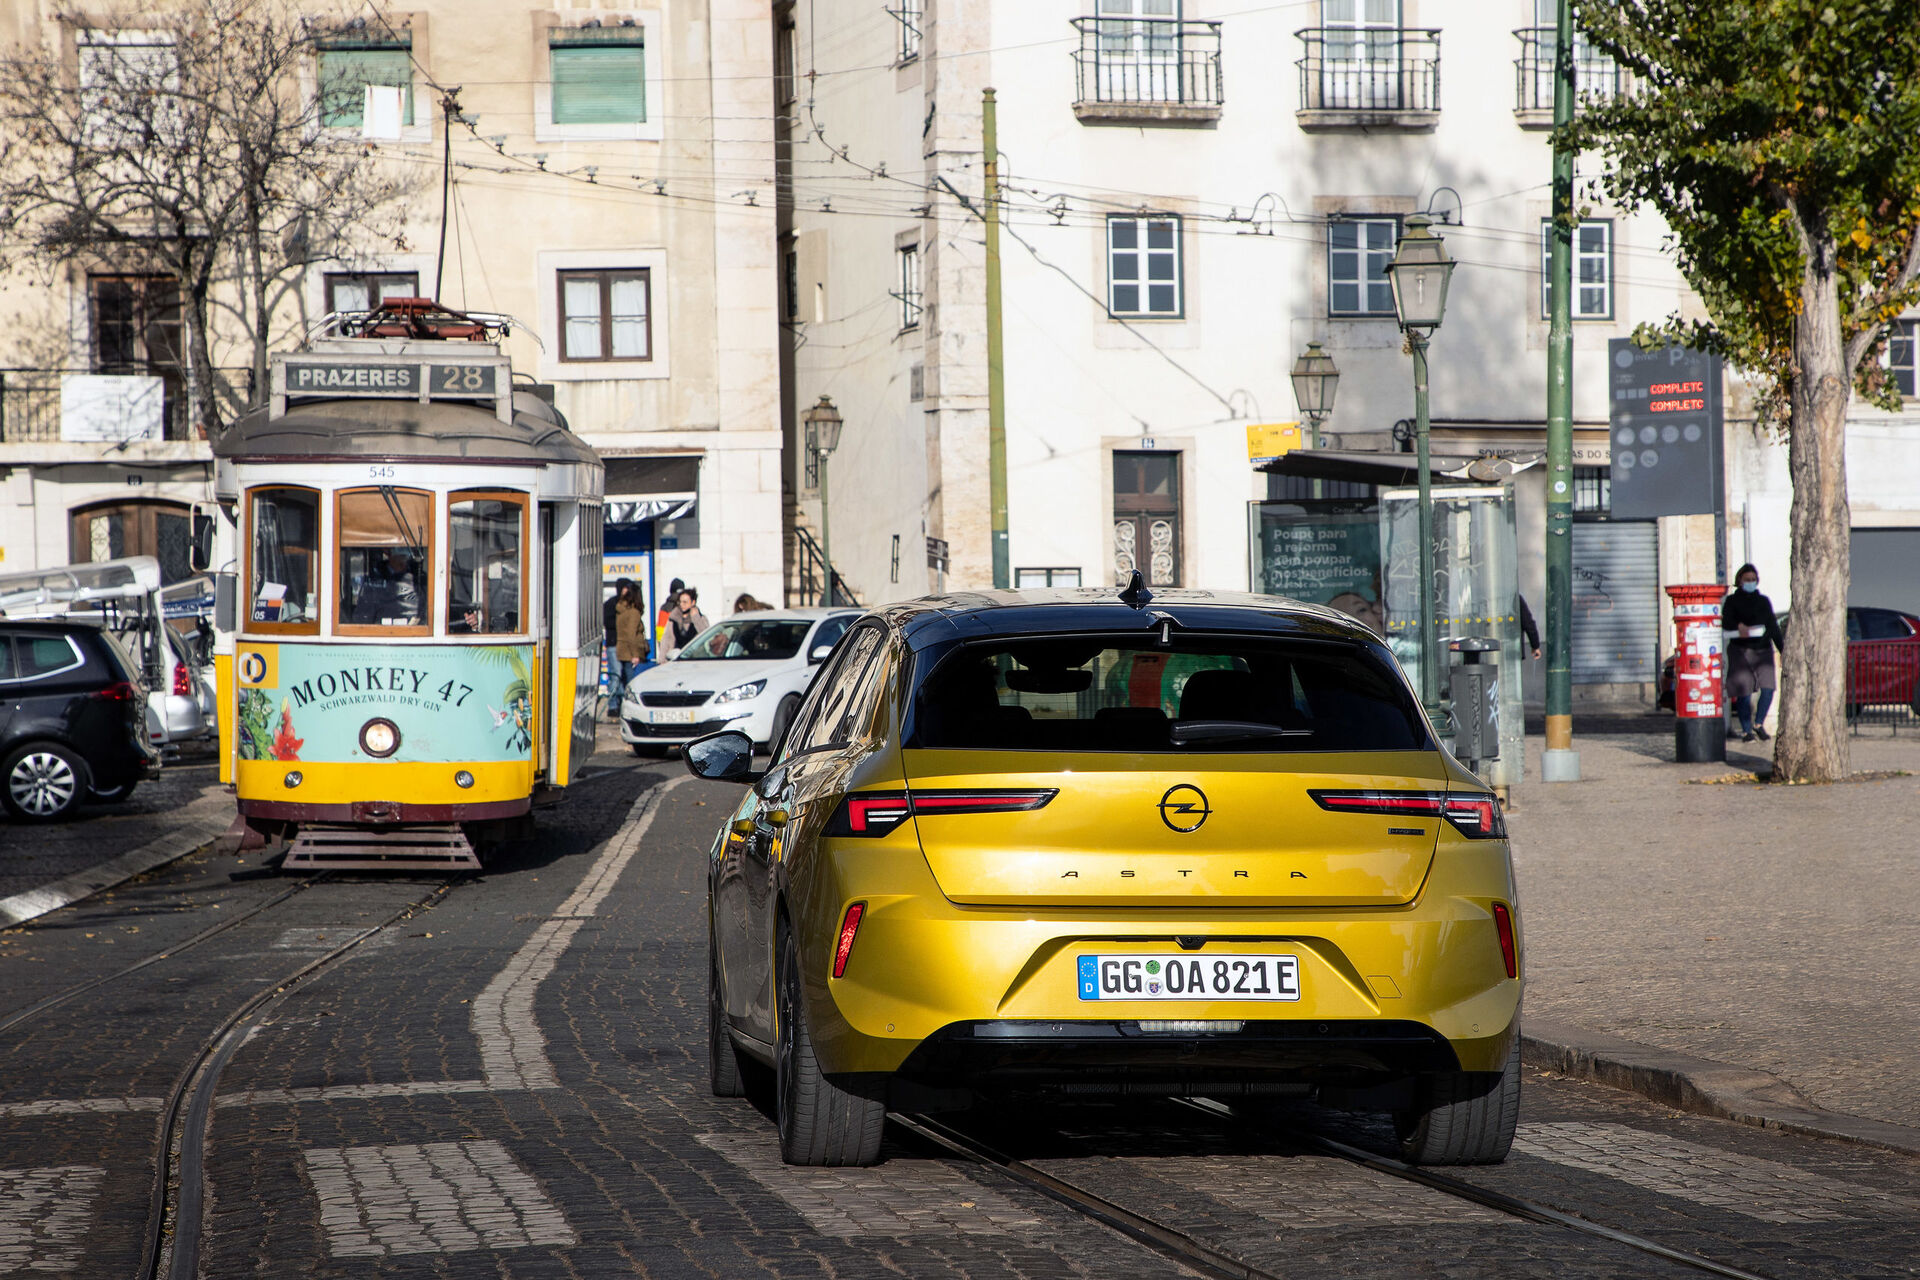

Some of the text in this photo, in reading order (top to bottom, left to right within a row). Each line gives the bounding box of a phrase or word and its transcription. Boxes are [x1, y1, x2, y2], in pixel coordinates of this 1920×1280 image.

[299, 366, 483, 390] PRAZERES 28
[1587, 450, 1601, 459] DO
[369, 466, 395, 478] 545
[1273, 529, 1347, 542] Poupe para
[1273, 541, 1337, 552] a reforma
[1273, 555, 1352, 567] sem poupar
[608, 564, 636, 573] ATM
[254, 611, 265, 620] 05
[290, 667, 474, 708] MONKEY 47
[320, 694, 442, 712] SCHWARZWALD DRY GIN
[1061, 870, 1307, 879] ASTRA
[1085, 982, 1093, 993] D
[1101, 960, 1142, 993] GG
[1165, 960, 1205, 993] OA
